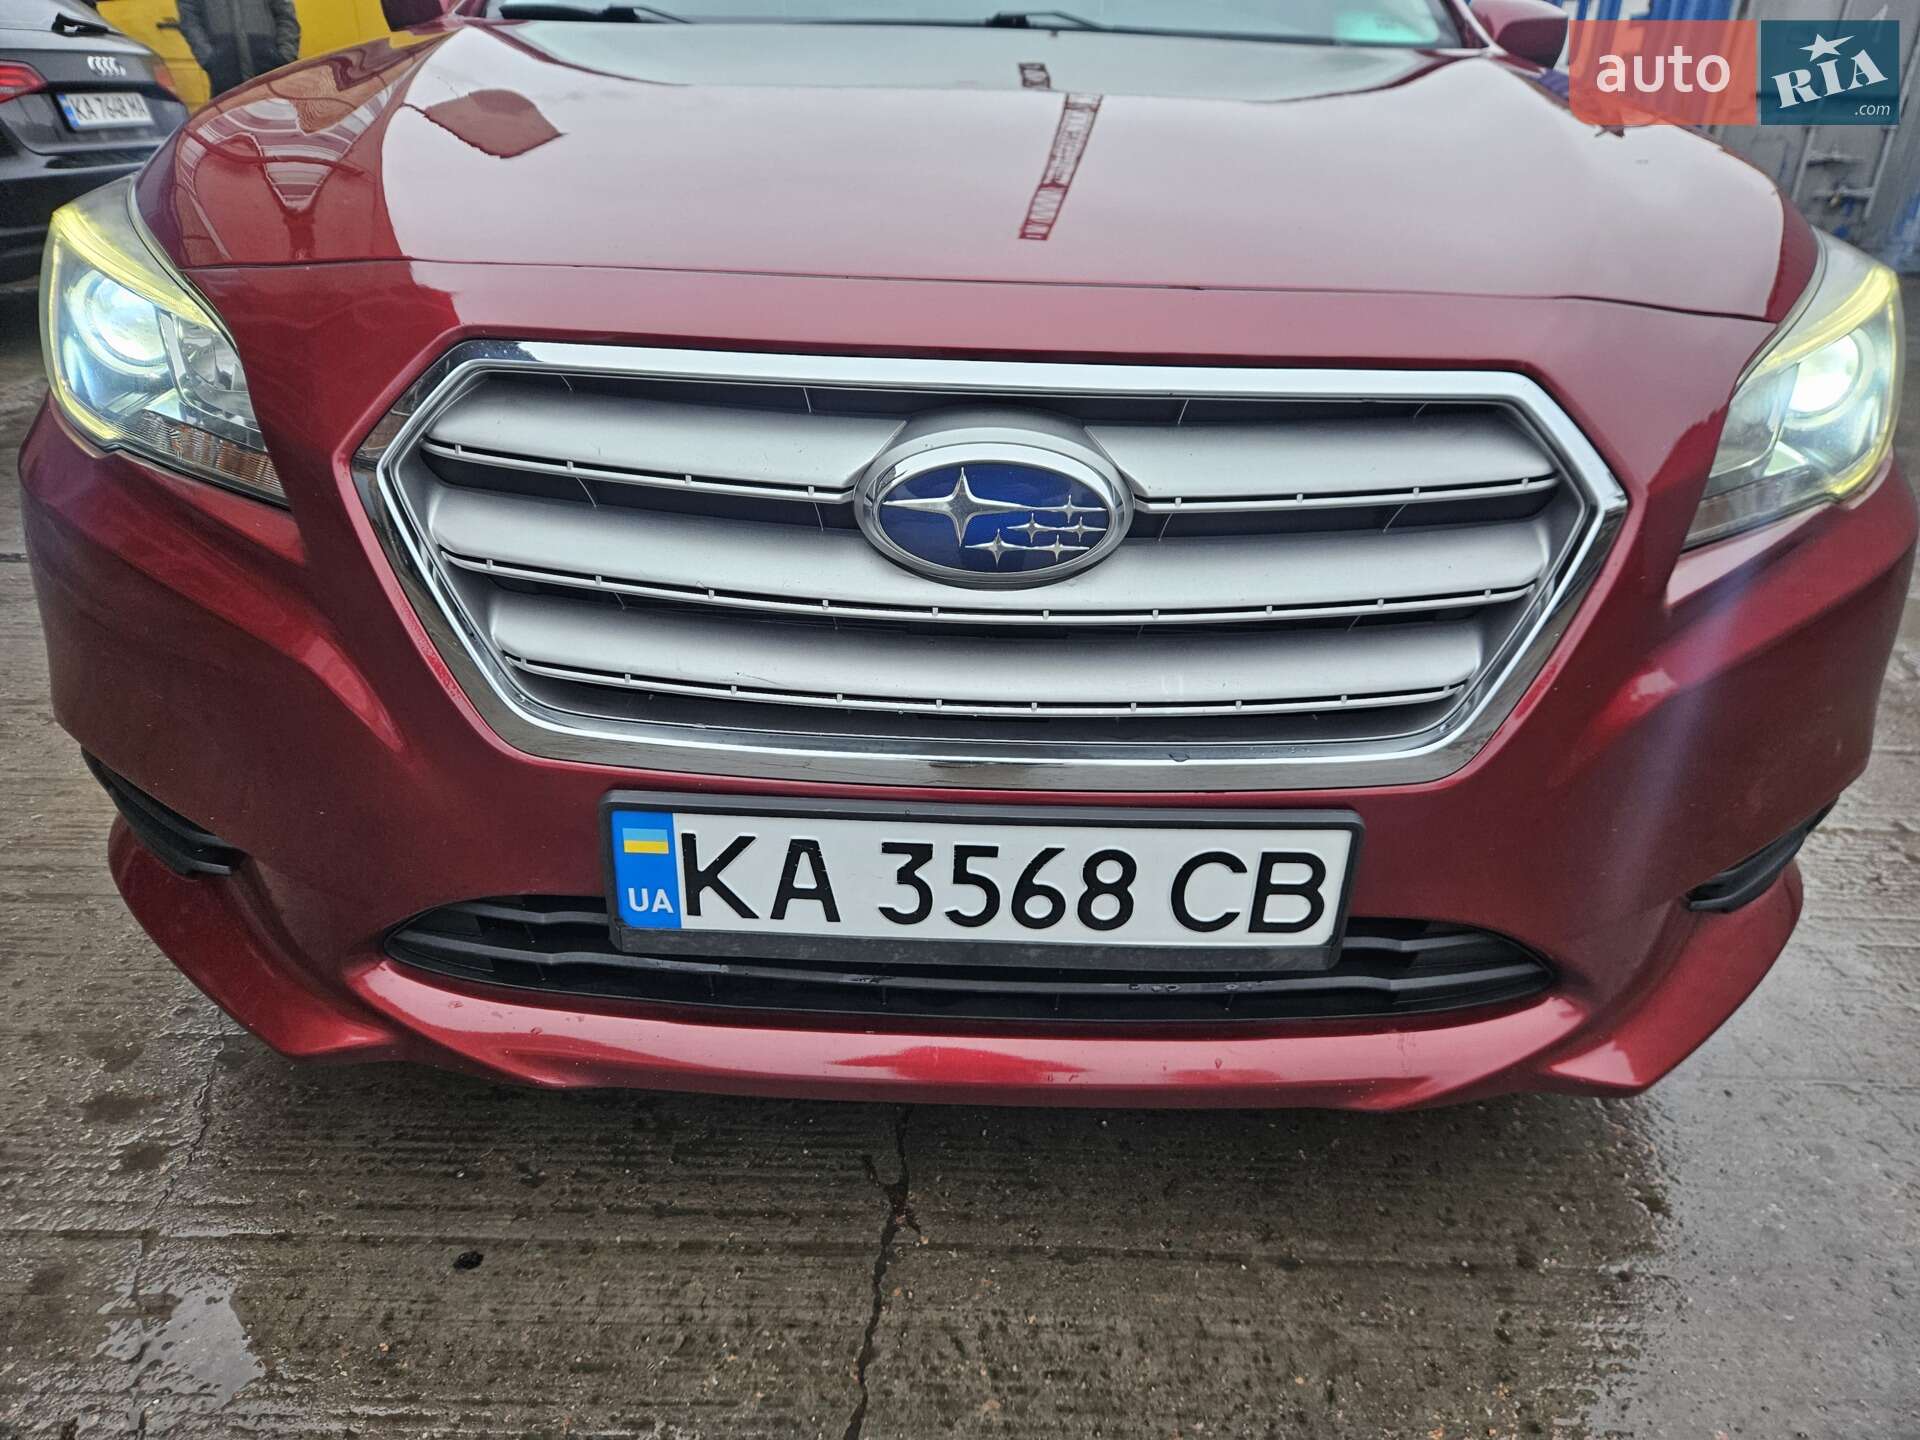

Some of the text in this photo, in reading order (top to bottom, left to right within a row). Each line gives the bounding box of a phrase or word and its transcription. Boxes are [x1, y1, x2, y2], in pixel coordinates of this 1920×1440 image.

[628, 888, 674, 913] UA
[681, 832, 1327, 933] KA 3568 CB
